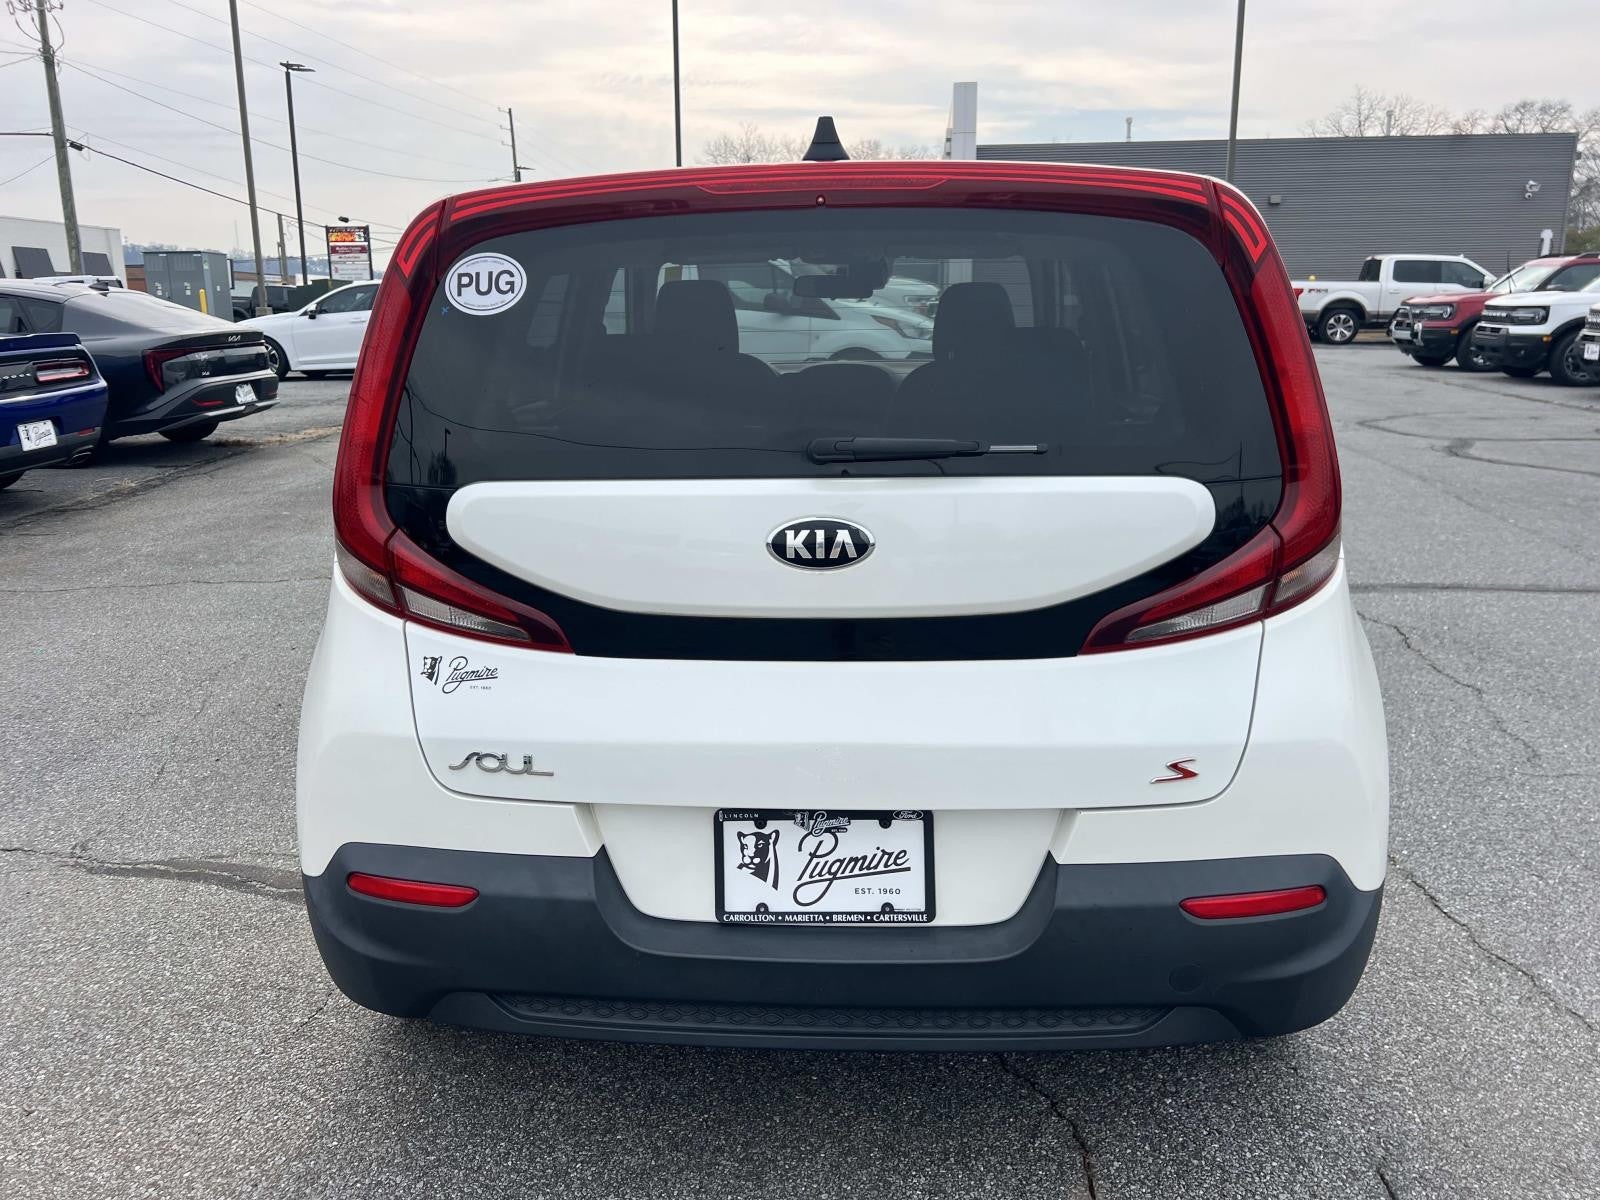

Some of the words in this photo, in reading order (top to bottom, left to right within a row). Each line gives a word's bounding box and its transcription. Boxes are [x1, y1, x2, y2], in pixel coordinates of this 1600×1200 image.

[457, 269, 515, 297] PUG
[785, 529, 857, 559] KIA
[442, 656, 499, 694] Pugmire
[448, 752, 554, 776] SOUL
[1149, 757, 1199, 784] S
[811, 810, 850, 836] Pugmire
[792, 831, 911, 907] Pugmire
[854, 887, 875, 895] EST.
[878, 887, 901, 895] 1960
[723, 913, 776, 922] CARROLLTON
[784, 913, 824, 922] MARIETTA
[832, 913, 865, 922] BREMEN
[873, 913, 928, 922] CARTERSVILLE
